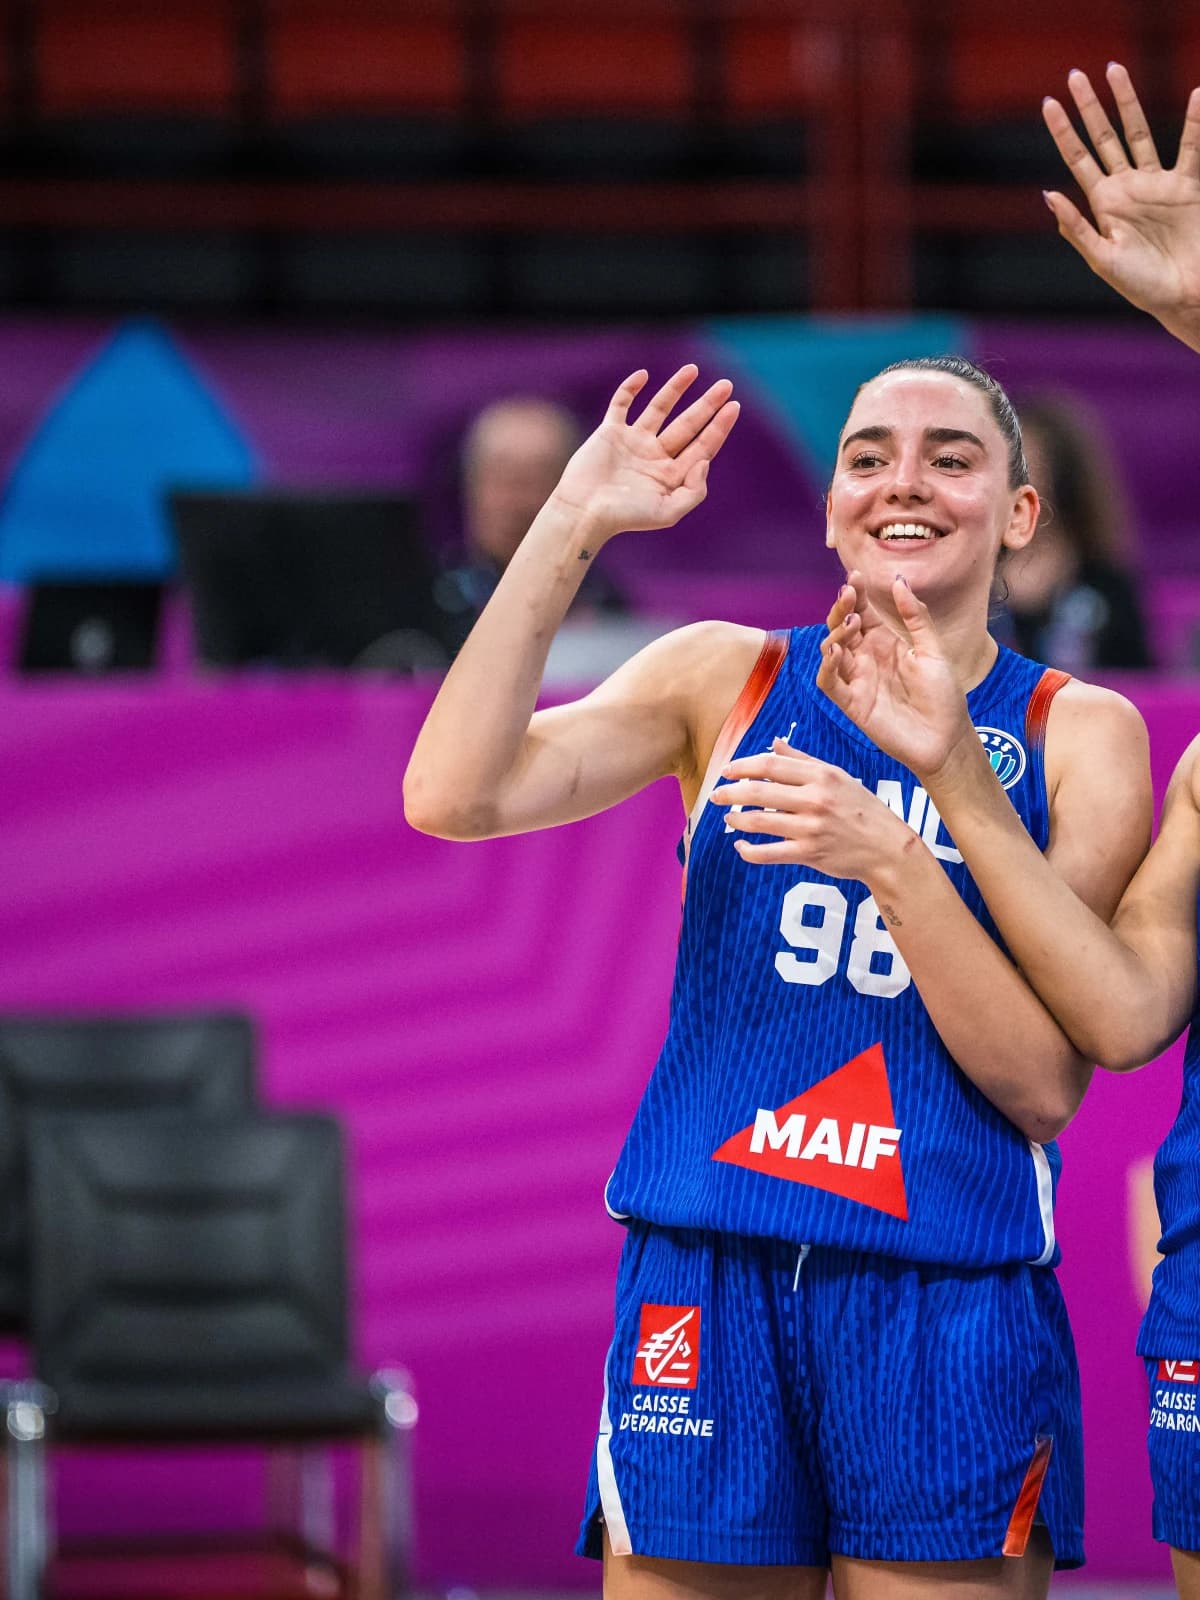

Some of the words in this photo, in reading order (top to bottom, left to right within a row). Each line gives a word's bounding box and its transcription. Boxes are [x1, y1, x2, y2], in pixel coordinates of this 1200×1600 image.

[774, 881, 912, 999] 98
[749, 1108, 903, 1170] MAIF
[632, 1393, 691, 1414] CAISSE
[1155, 1389, 1197, 1412] CAISSE
[619, 1412, 715, 1437] D'EPARGNE
